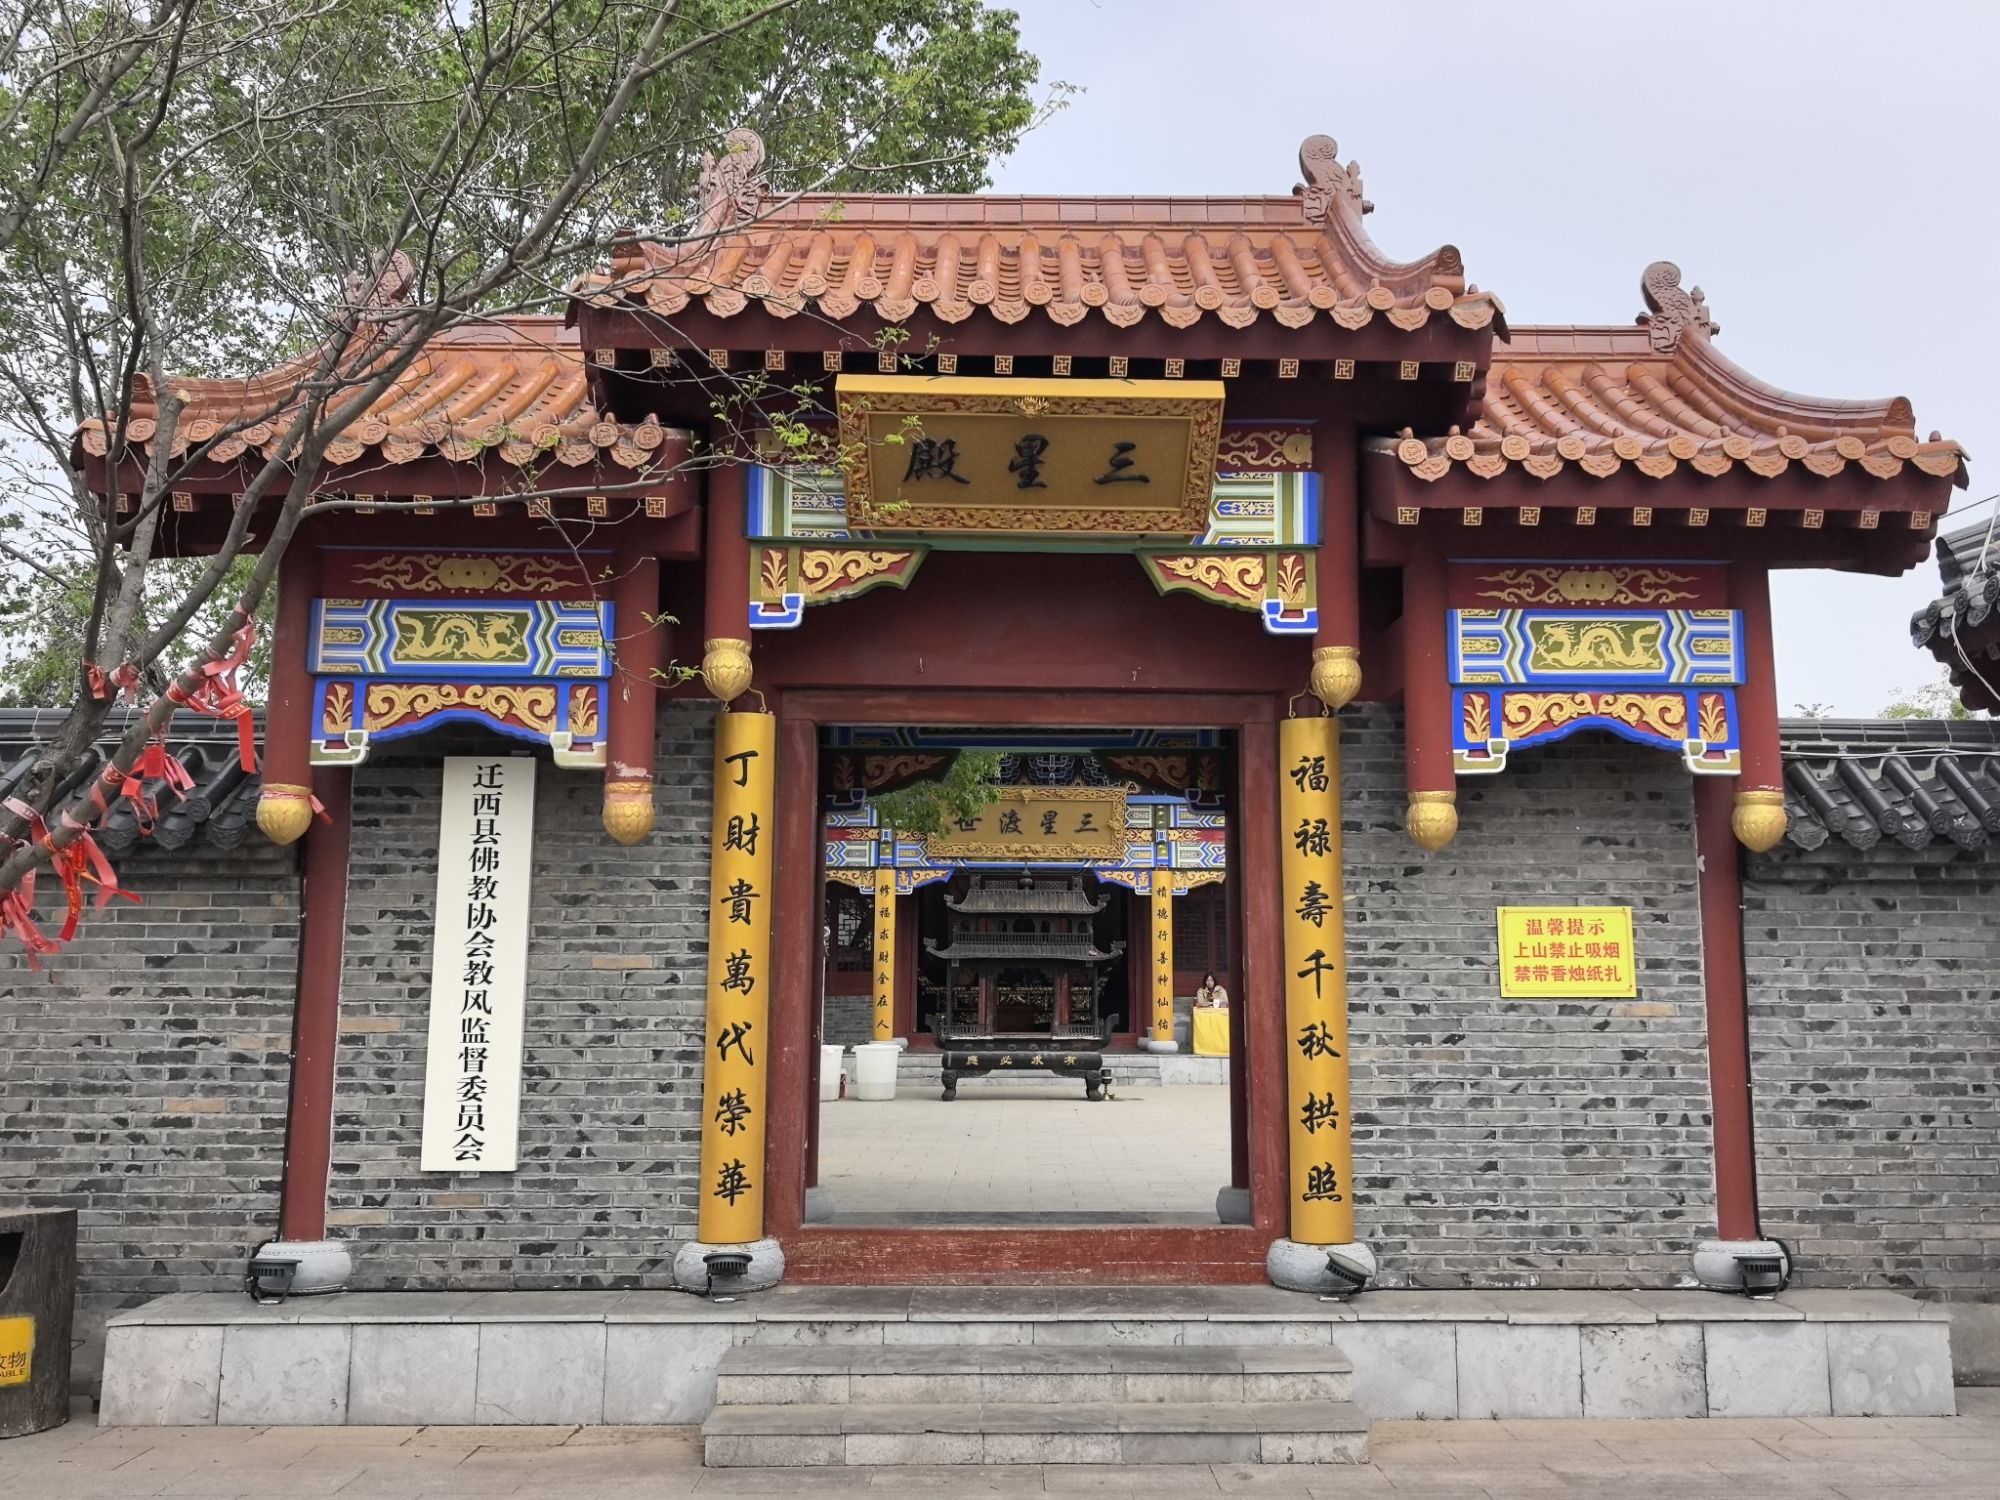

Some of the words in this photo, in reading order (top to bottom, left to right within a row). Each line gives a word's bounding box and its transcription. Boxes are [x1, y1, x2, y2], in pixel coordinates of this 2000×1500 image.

[902, 434, 1150, 490] 三星殿
[1526, 918, 1605, 936] 温馨提示
[453, 763, 504, 1162] 迁西县佛教协会教风监督委员会
[1513, 942, 1620, 959] 上山禁止吸烟
[714, 750, 761, 1207] 丁財貴萬代榮華
[1514, 965, 1622, 983] 禁带香烛纸扎
